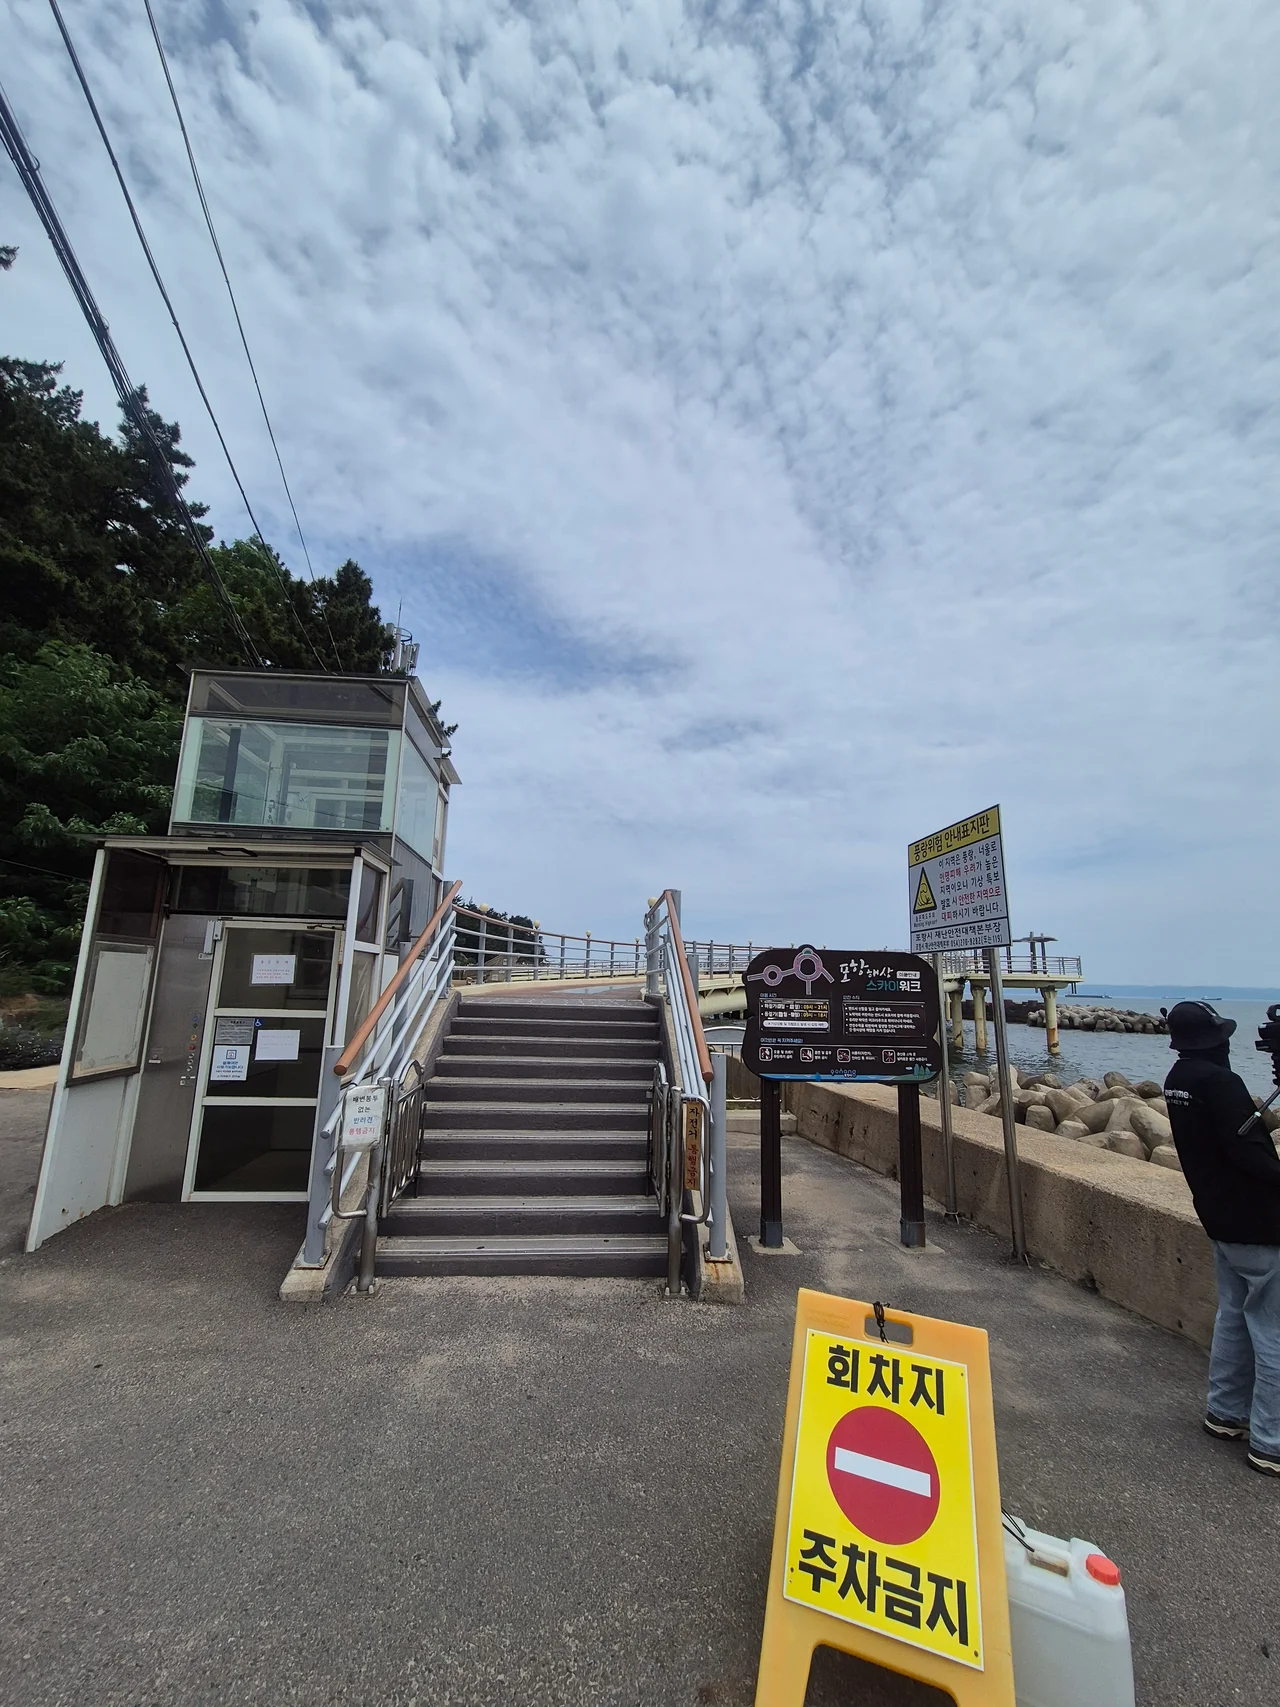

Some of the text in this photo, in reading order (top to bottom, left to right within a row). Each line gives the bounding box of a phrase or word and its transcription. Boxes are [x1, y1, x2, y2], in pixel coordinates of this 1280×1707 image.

[914, 814, 989, 861] 풍랑위험 안내표지판
[939, 860, 943, 868] 이
[945, 854, 960, 867] 지역은
[979, 841, 997, 856] 너울로
[939, 856, 998, 884] 인명피해 우려가 높은
[940, 871, 1000, 895] 지역이오니 기상 특보
[940, 886, 1001, 911] 발효 시 안전한 지역으로
[941, 901, 1002, 921] 대피하시기 바랍니다.
[915, 922, 1001, 942] 포항시 재난안전대책본부장
[839, 959, 894, 983] 포항 해상
[866, 980, 922, 992] 스카이워크
[353, 1095, 378, 1103] 배변봉투
[354, 1117, 373, 1125] 반려견
[688, 1106, 699, 1188] 자전거 통행금지
[826, 1344, 945, 1416] 회차지
[798, 1528, 969, 1646] 주차금지
